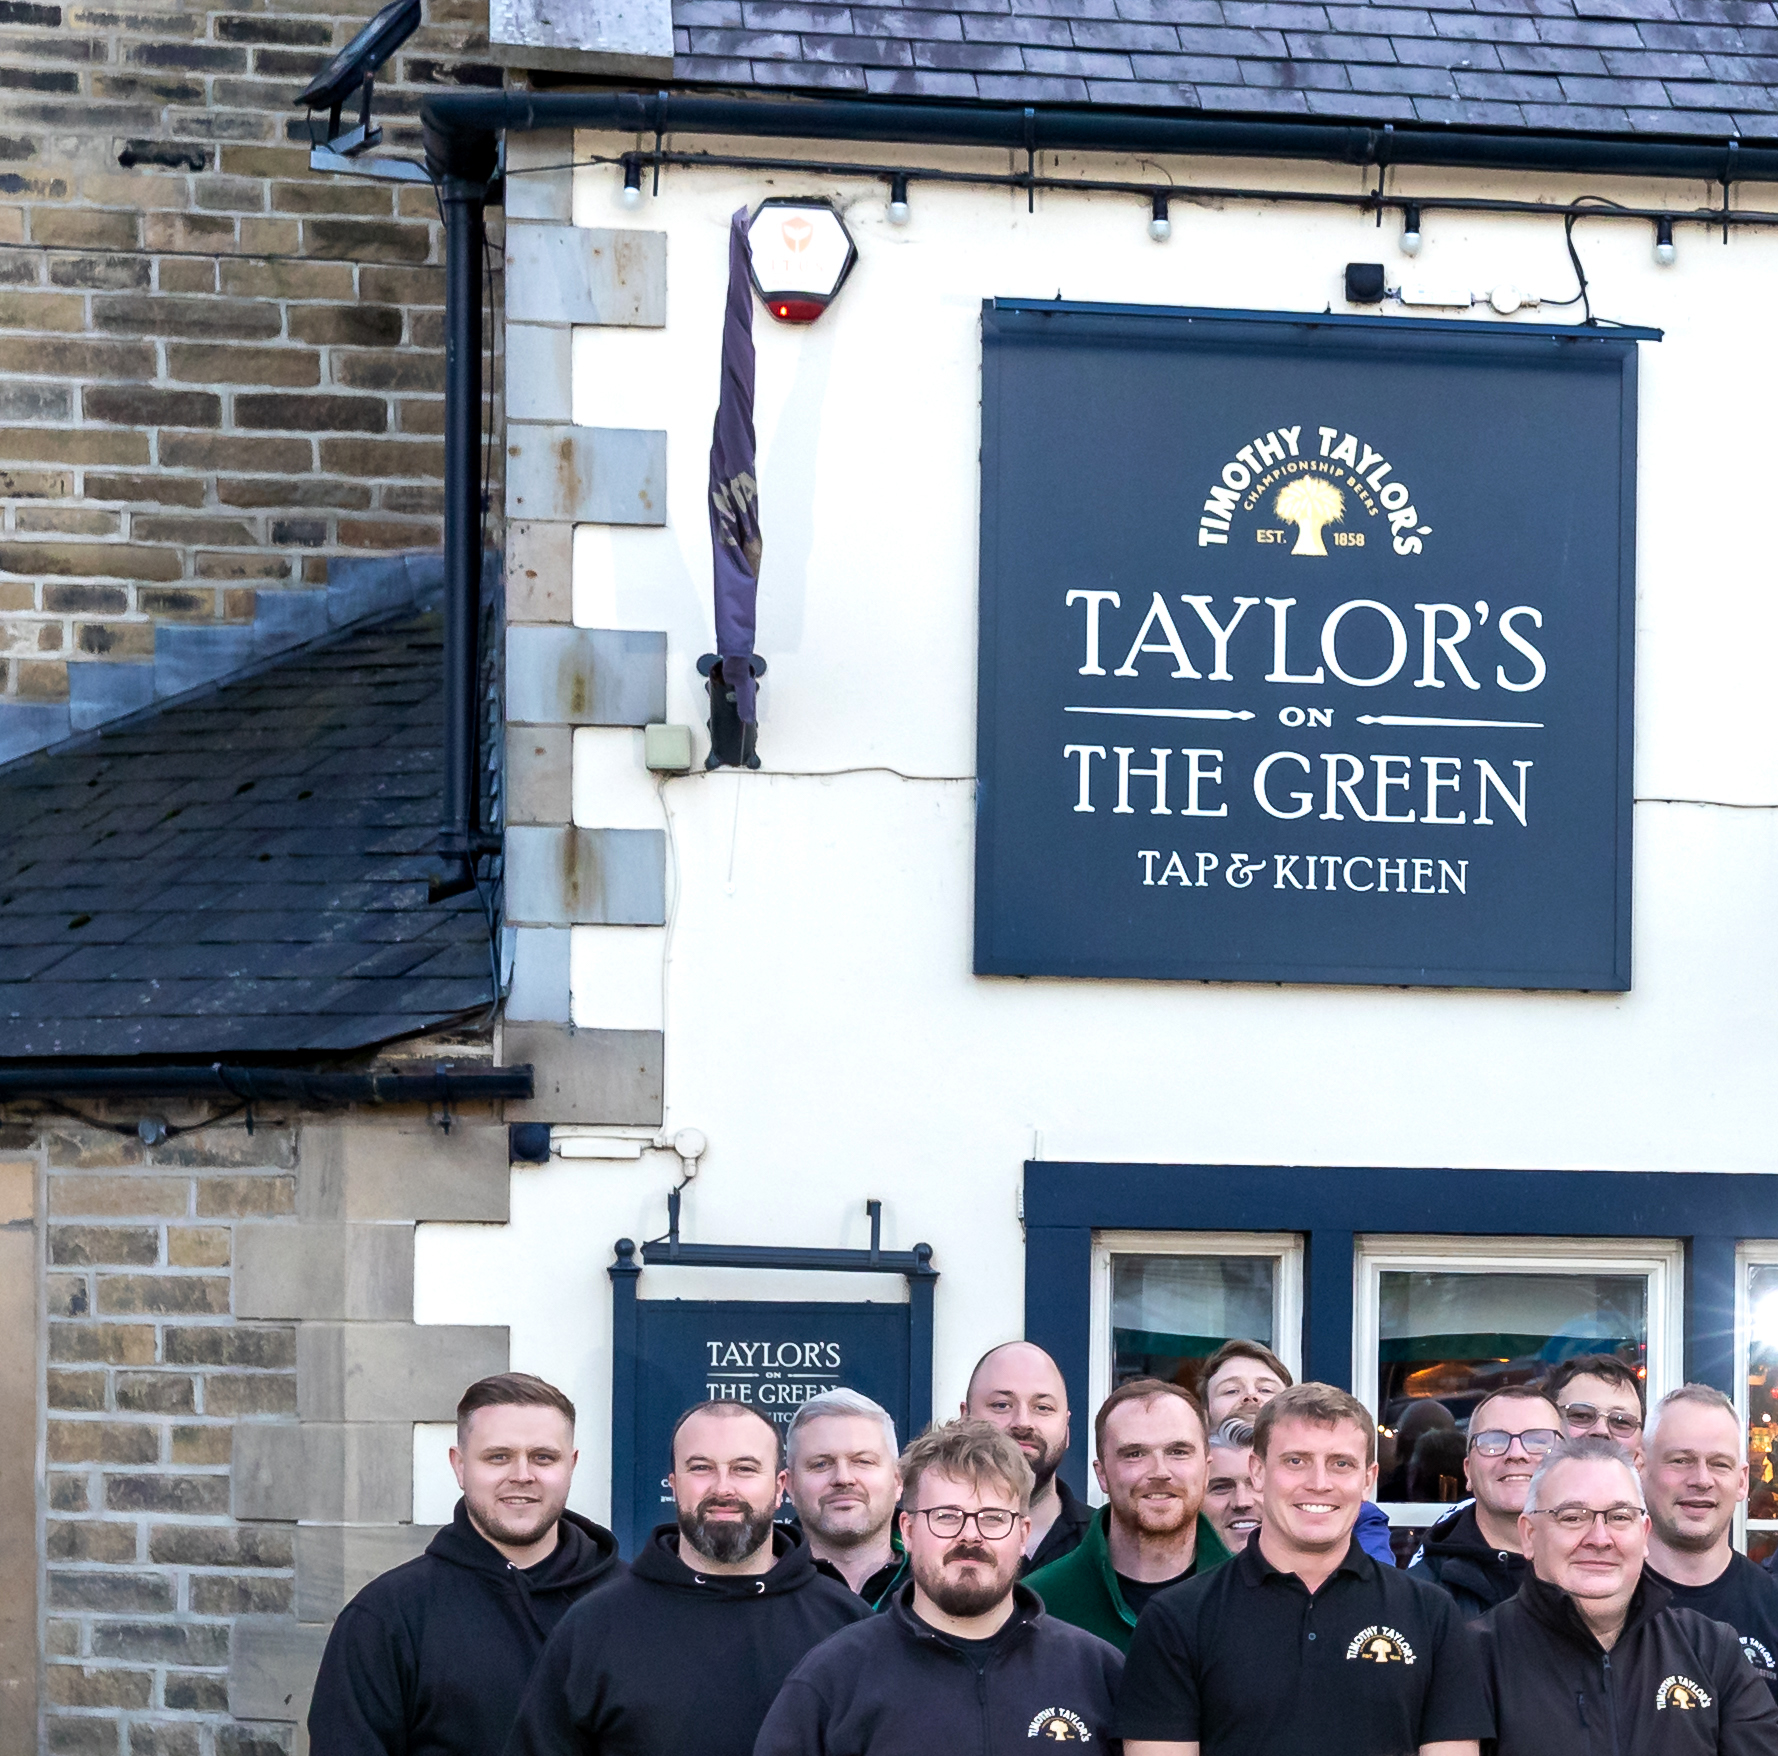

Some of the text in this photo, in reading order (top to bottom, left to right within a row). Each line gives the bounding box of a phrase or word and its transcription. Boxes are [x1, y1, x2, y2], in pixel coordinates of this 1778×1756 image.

[1198, 425, 1433, 556] TIMOTHY TAYLOR'S
[1243, 460, 1379, 517] CHAMPIONSHIP BEERS
[1255, 529, 1365, 547] EST. 1858
[1065, 588, 1547, 692] TAYLOR'S
[1278, 706, 1334, 729] ON
[1063, 744, 1534, 827] THE GREEN
[1137, 850, 1469, 895] TAP & KITCHEN
[706, 1341, 841, 1368] TAYLOR'S
[765, 1371, 782, 1379] ON
[705, 1383, 753, 1404] THE
[1346, 1625, 1417, 1665] TIMOTHY TAYLOR'S
[1655, 1675, 1712, 1711] TIMOTHY TAYLOR'S
[1027, 1706, 1092, 1742] TIMOTHY TAYLOR'S
